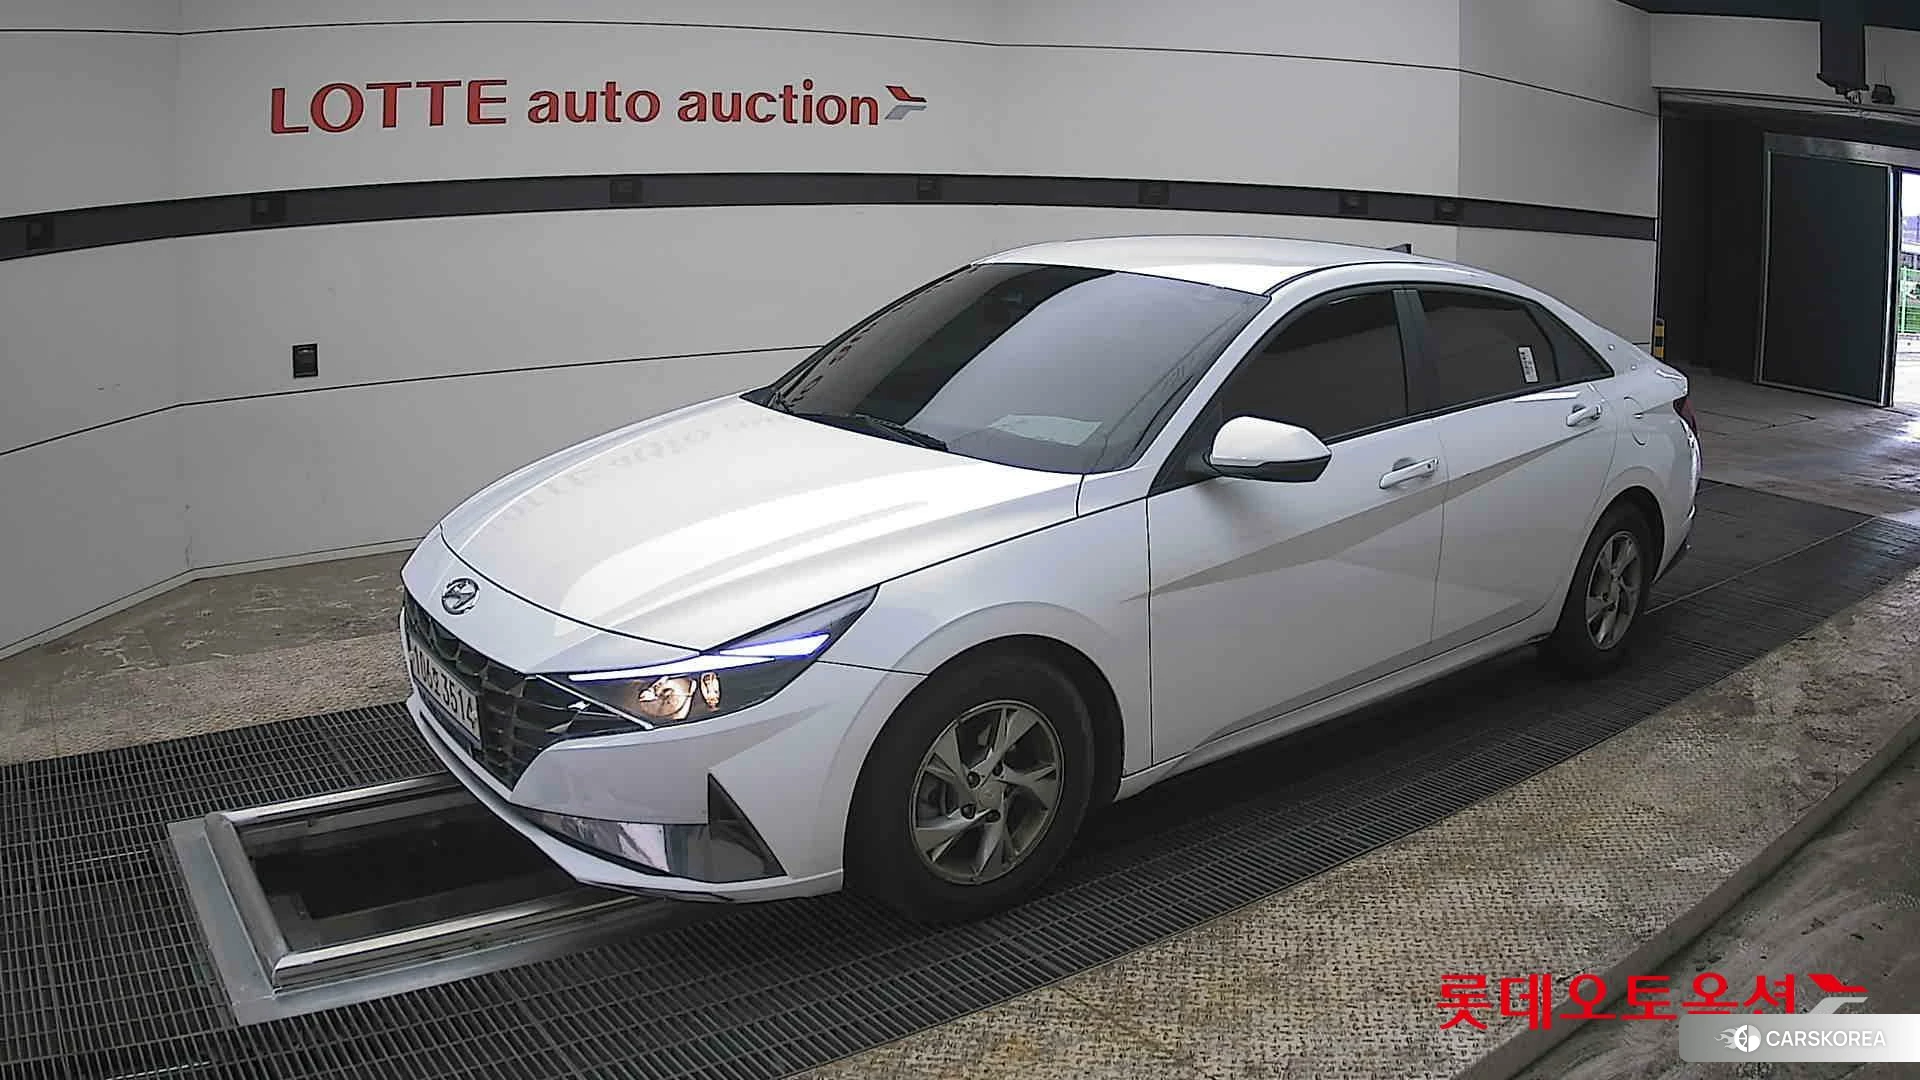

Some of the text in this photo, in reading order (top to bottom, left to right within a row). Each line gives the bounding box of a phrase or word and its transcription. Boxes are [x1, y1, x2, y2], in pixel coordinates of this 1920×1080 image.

[269, 78, 880, 135] LOTTE auto auction
